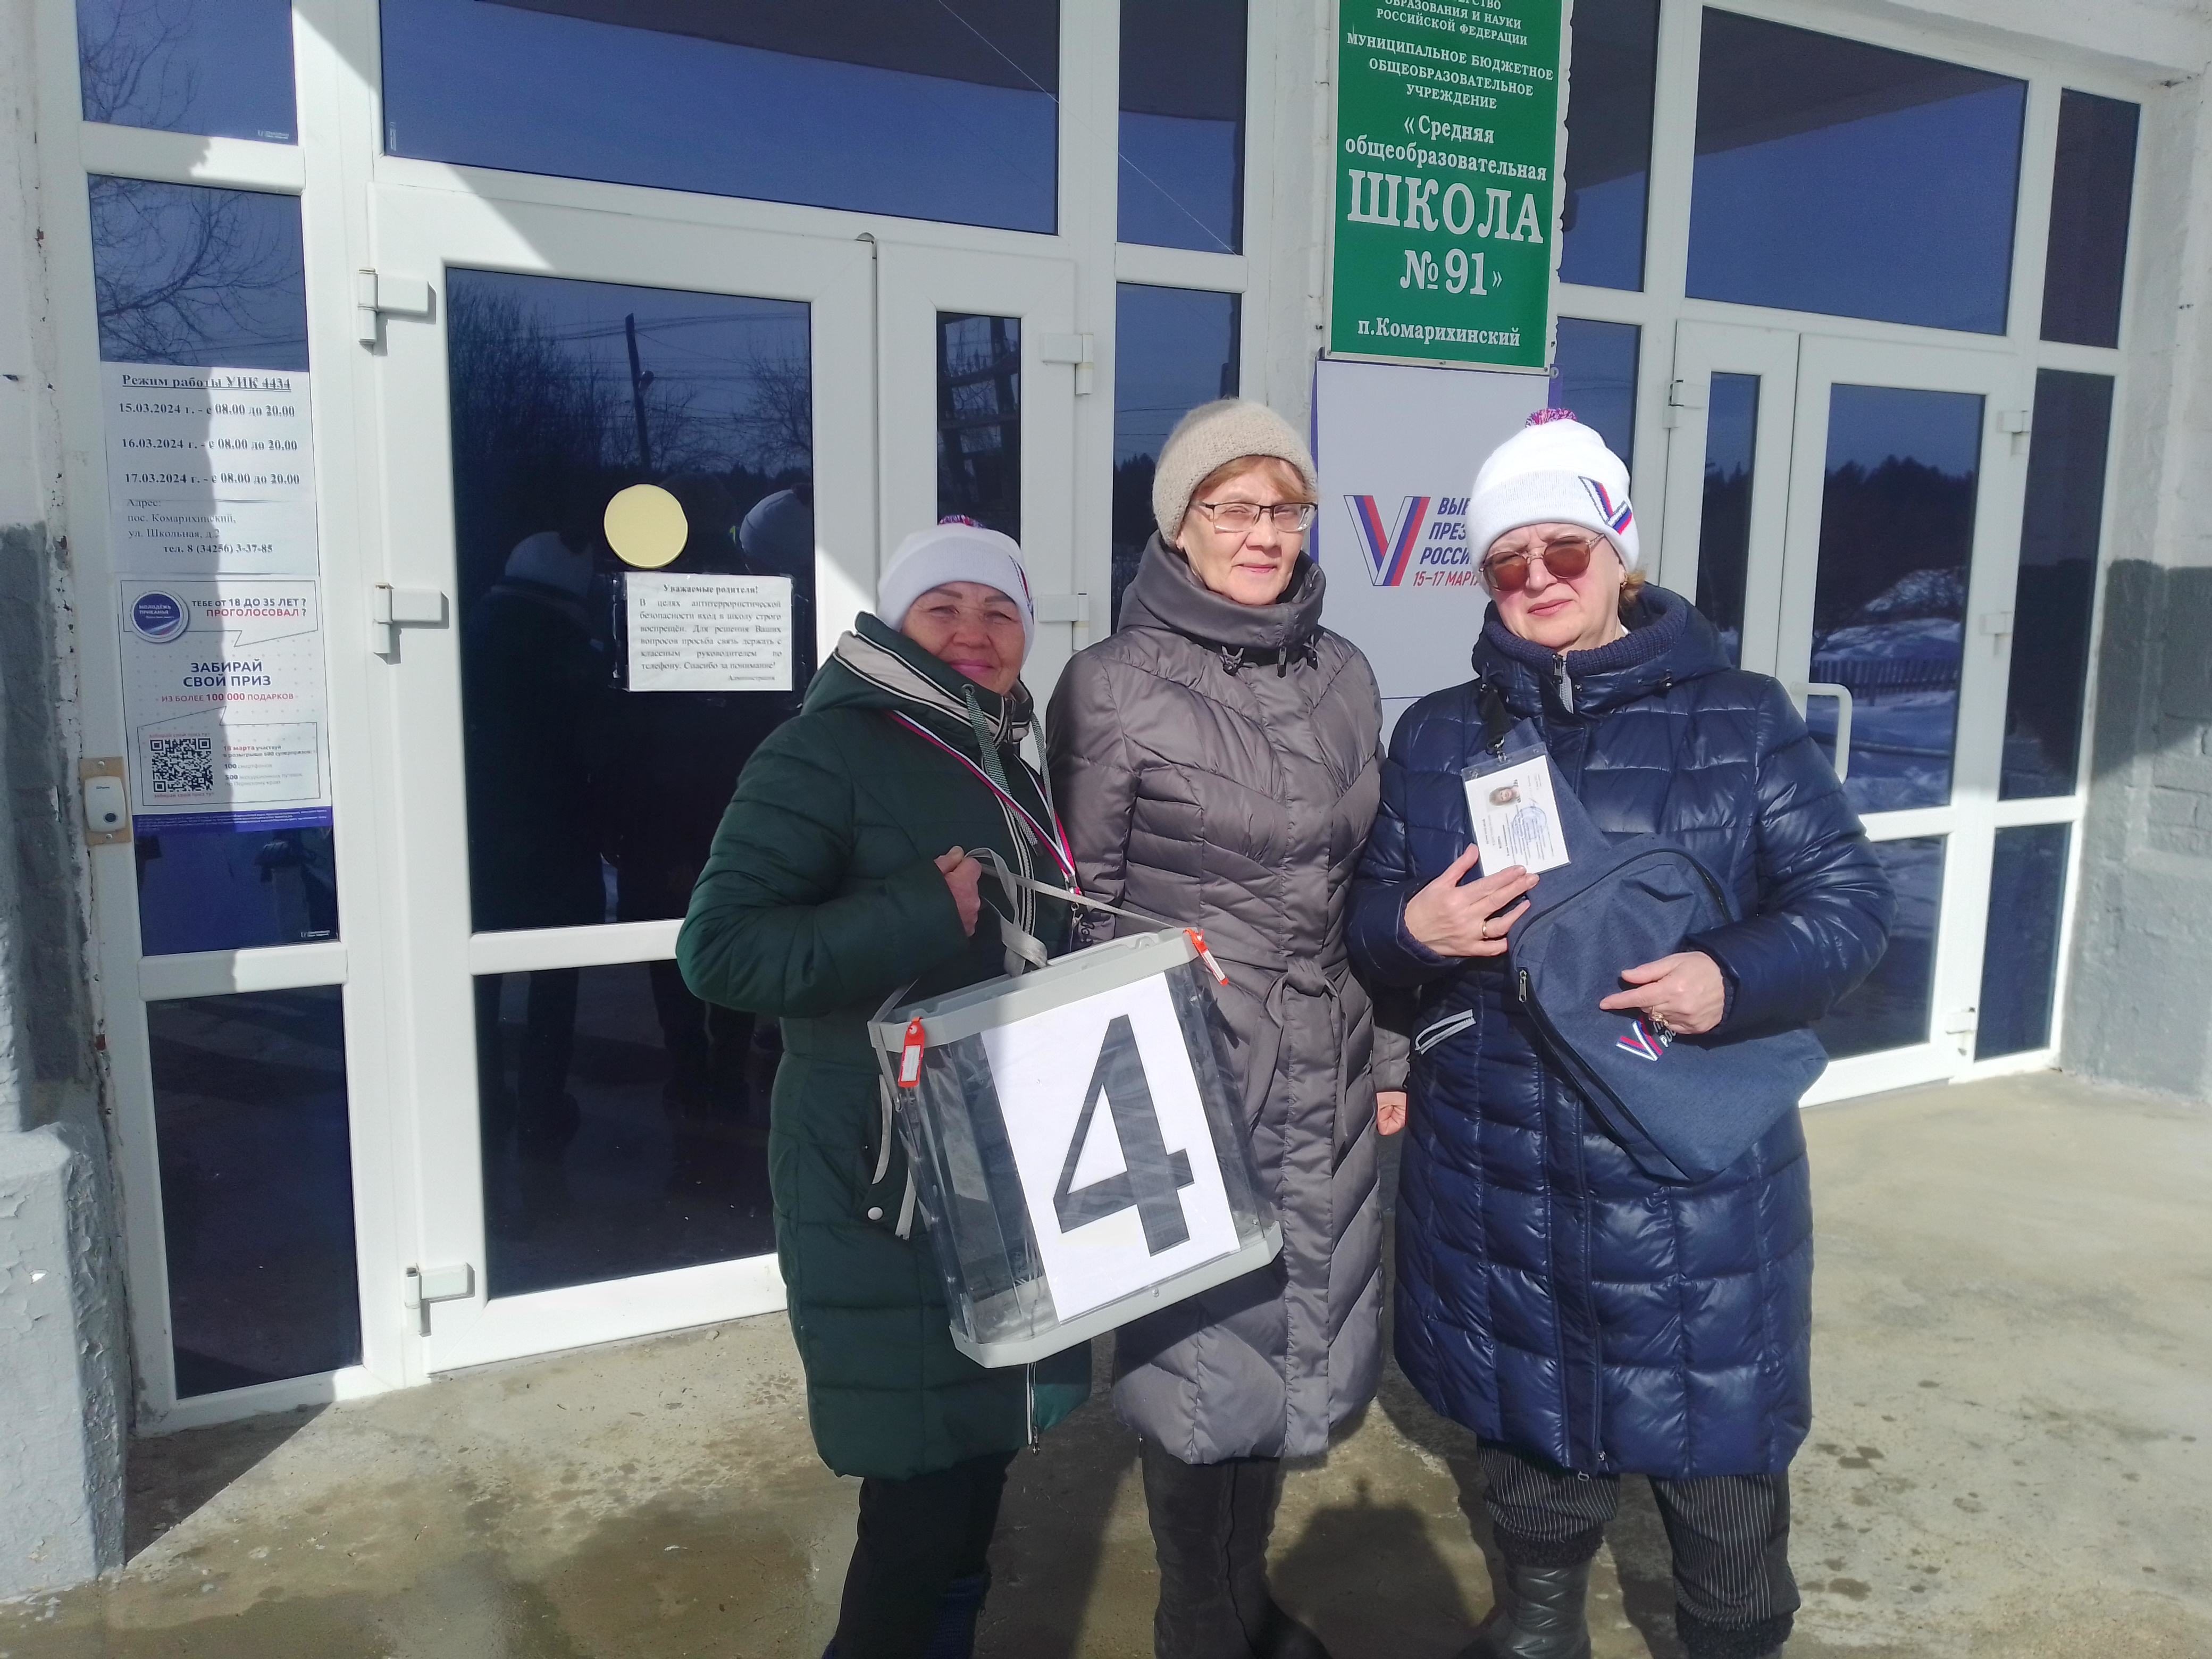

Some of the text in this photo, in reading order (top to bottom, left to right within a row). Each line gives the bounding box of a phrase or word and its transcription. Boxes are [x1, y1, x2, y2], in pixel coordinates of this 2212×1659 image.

[1472, 11, 1481, 21] И
[1485, 13, 1521, 29] НАУКИ
[1377, 9, 1528, 46] РОССИЙСКОЙ ФЕДЕРАЦИИ
[1347, 32, 1553, 81] МУНИЦИПАЛЬНОЕ БЮДЖЕТНОЕ
[1369, 58, 1534, 96] ОБЩЕОБРАЗОВАТЕЛЬНОЕ
[1406, 83, 1497, 108] УЧРЕЖДЕНИЕ
[1345, 135, 1547, 181] общеобразовательная
[1347, 169, 1544, 244] ШКОЛА
[1358, 317, 1520, 347] п.Комарихинский
[122, 374, 291, 389] Режим работы УИК 4434
[119, 403, 180, 414] 15.03.2024
[186, 405, 195, 414] г.
[215, 404, 245, 415] 08.00
[248, 407, 262, 417] до
[266, 405, 295, 417] 20.00
[122, 439, 183, 449] 16.03.2024
[218, 439, 248, 450] 08.00
[252, 441, 264, 450] до
[268, 440, 297, 451] 20.00
[125, 473, 186, 483] 17.03.2024
[221, 473, 250, 484] 08.00
[254, 476, 266, 485] до
[271, 474, 299, 484] 20.00
[127, 499, 161, 509] Адрес:
[128, 530, 143, 539] ул.
[164, 543, 273, 555] тел. 8 (34256) 3-37-85
[1420, 547, 1471, 565] РОССИ
[663, 584, 758, 595] Уважаемые родители!
[244, 599, 259, 608] ДО
[640, 598, 646, 607] В
[206, 608, 307, 617] ПРОГОЛОСОВАЛ ?
[640, 611, 694, 620] безопасности
[692, 624, 708, 633] Для
[682, 637, 713, 646] просьба
[697, 650, 757, 658] руководителем
[191, 658, 263, 673] ЗАБИРАЙ
[641, 662, 681, 671] телефону.
[730, 661, 776, 669] понимание!
[183, 673, 271, 688] СВОЙ ПРИЗ
[227, 693, 245, 701] 000
[247, 693, 293, 702] ПОДАРКОВ
[1053, 1014, 1195, 1256] 4
